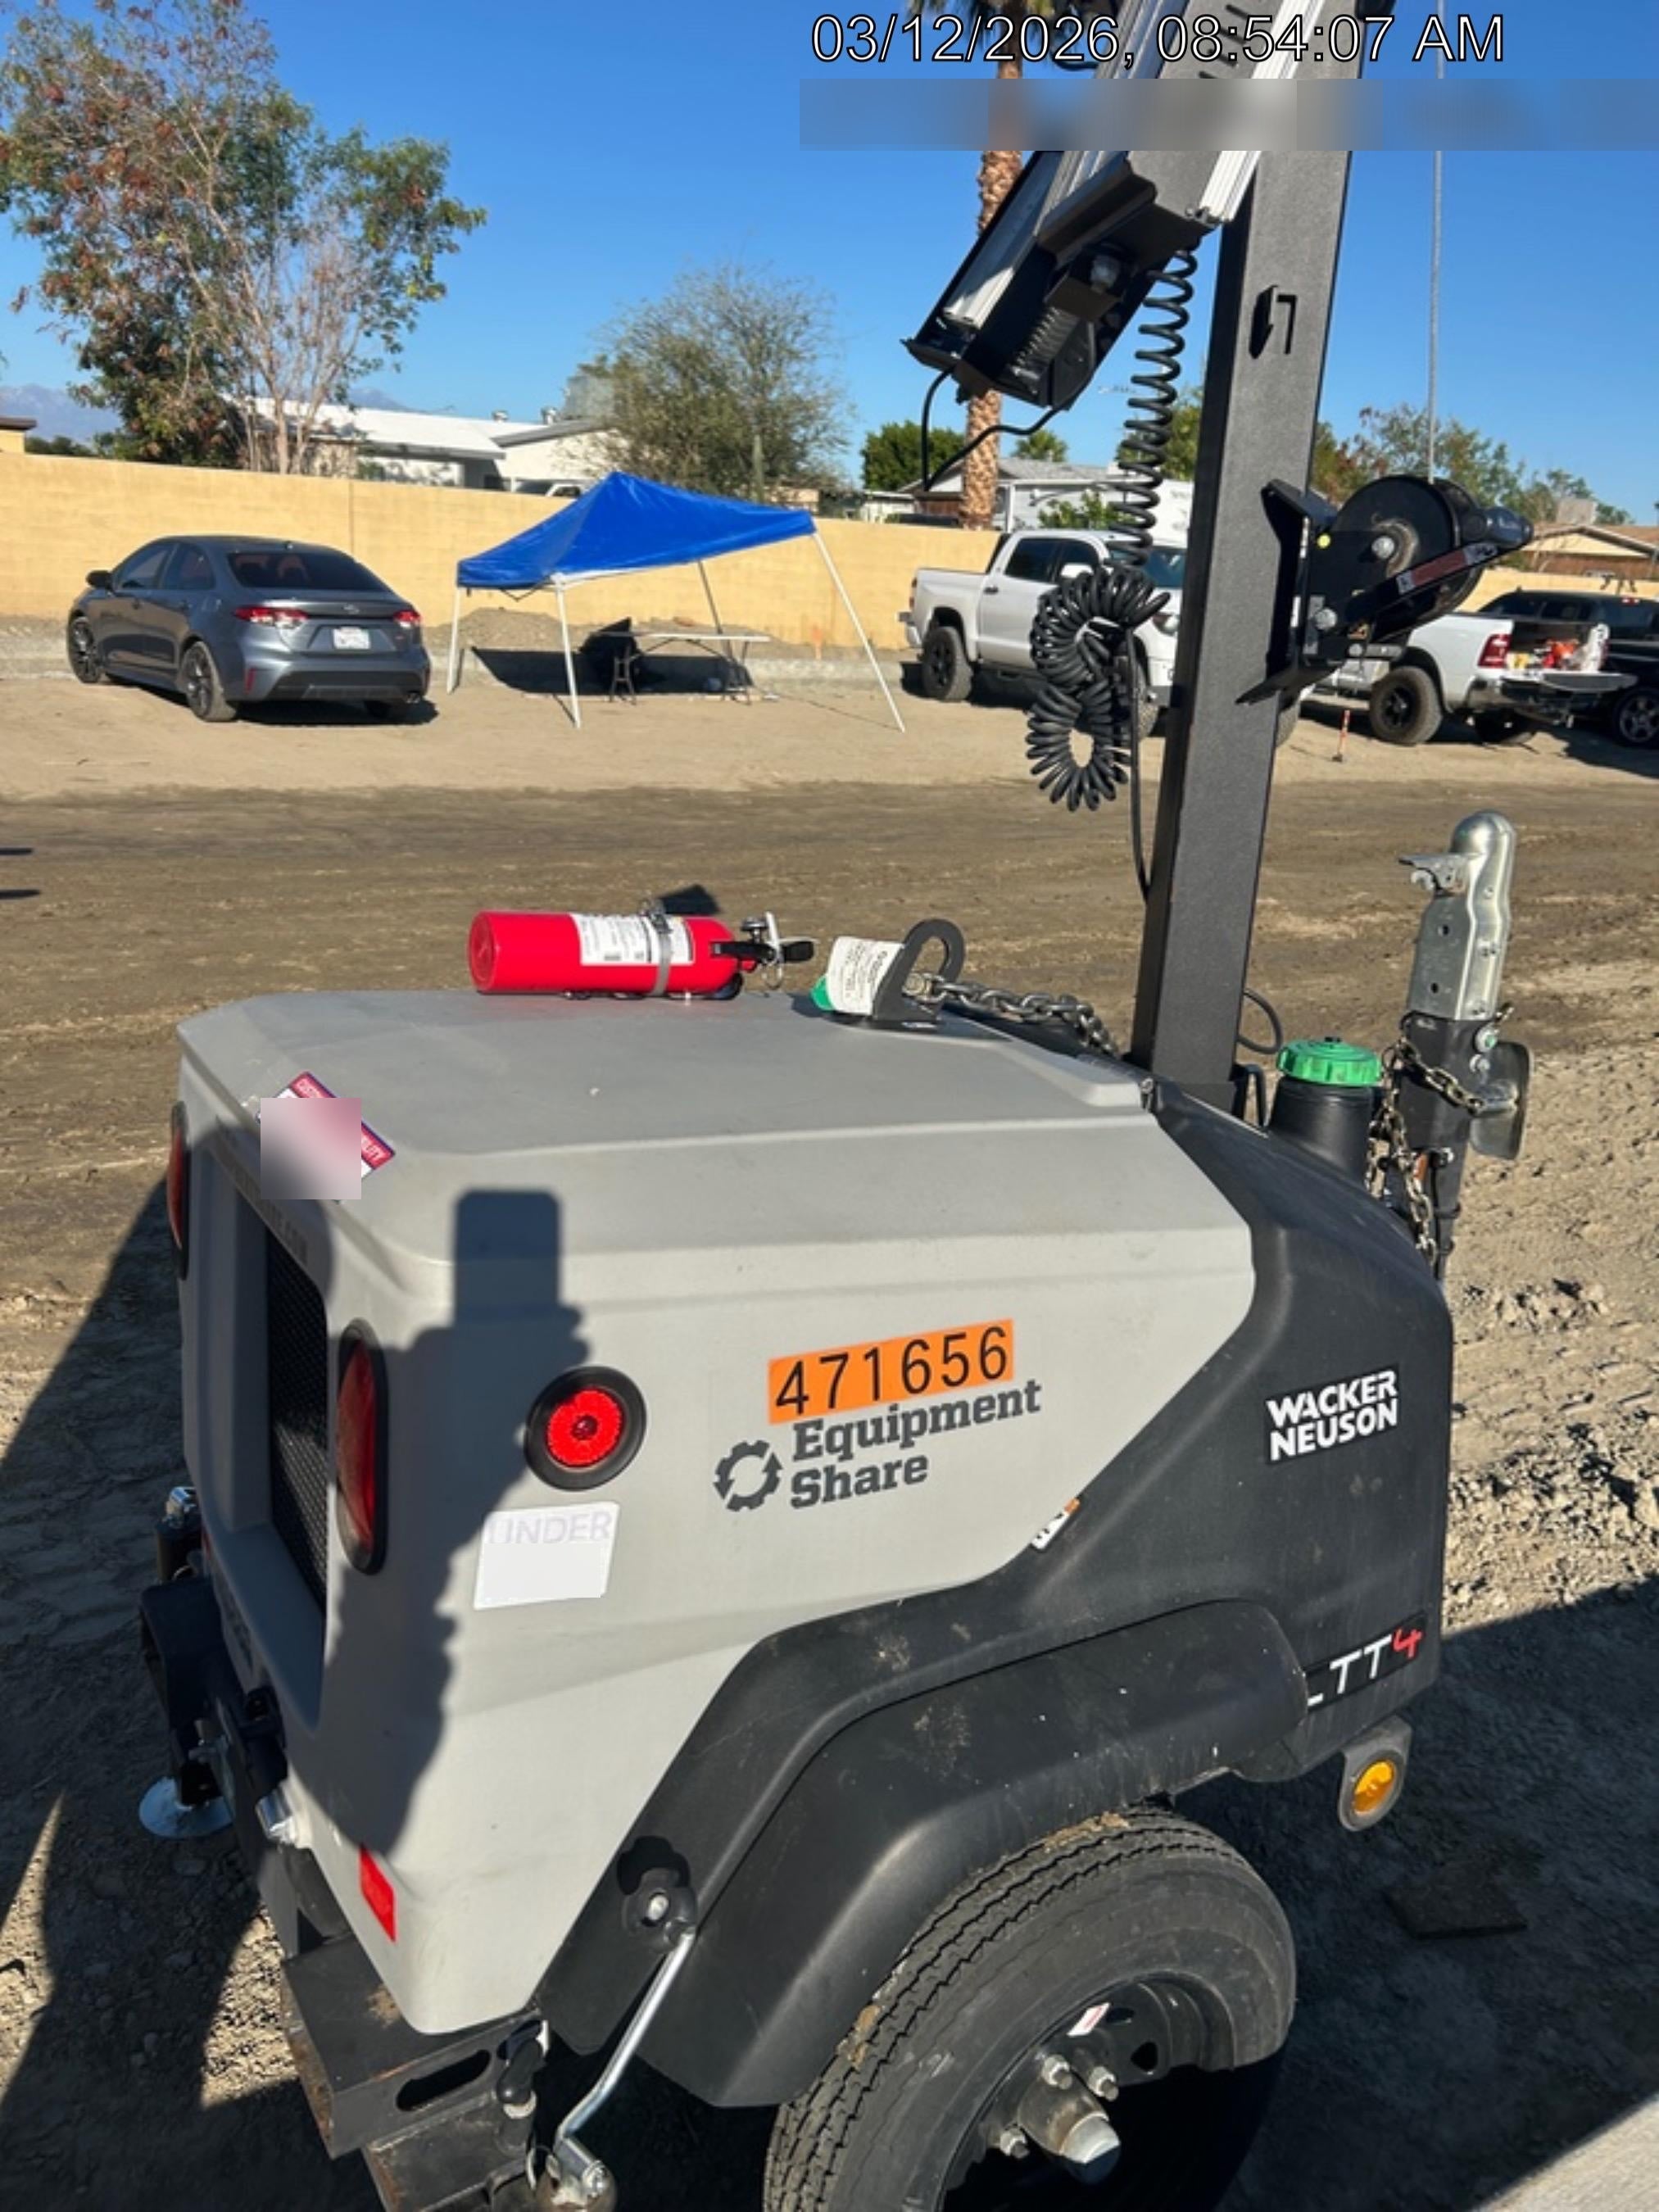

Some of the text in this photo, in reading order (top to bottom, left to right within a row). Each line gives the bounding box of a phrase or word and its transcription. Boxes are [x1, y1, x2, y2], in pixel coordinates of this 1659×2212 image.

[776, 1326, 1008, 1416] 471656
[1266, 1370, 1398, 1428] WACKER
[792, 1379, 1042, 1462] Equipment
[1270, 1398, 1398, 1462] NEUSON
[791, 1455, 929, 1509] Share
